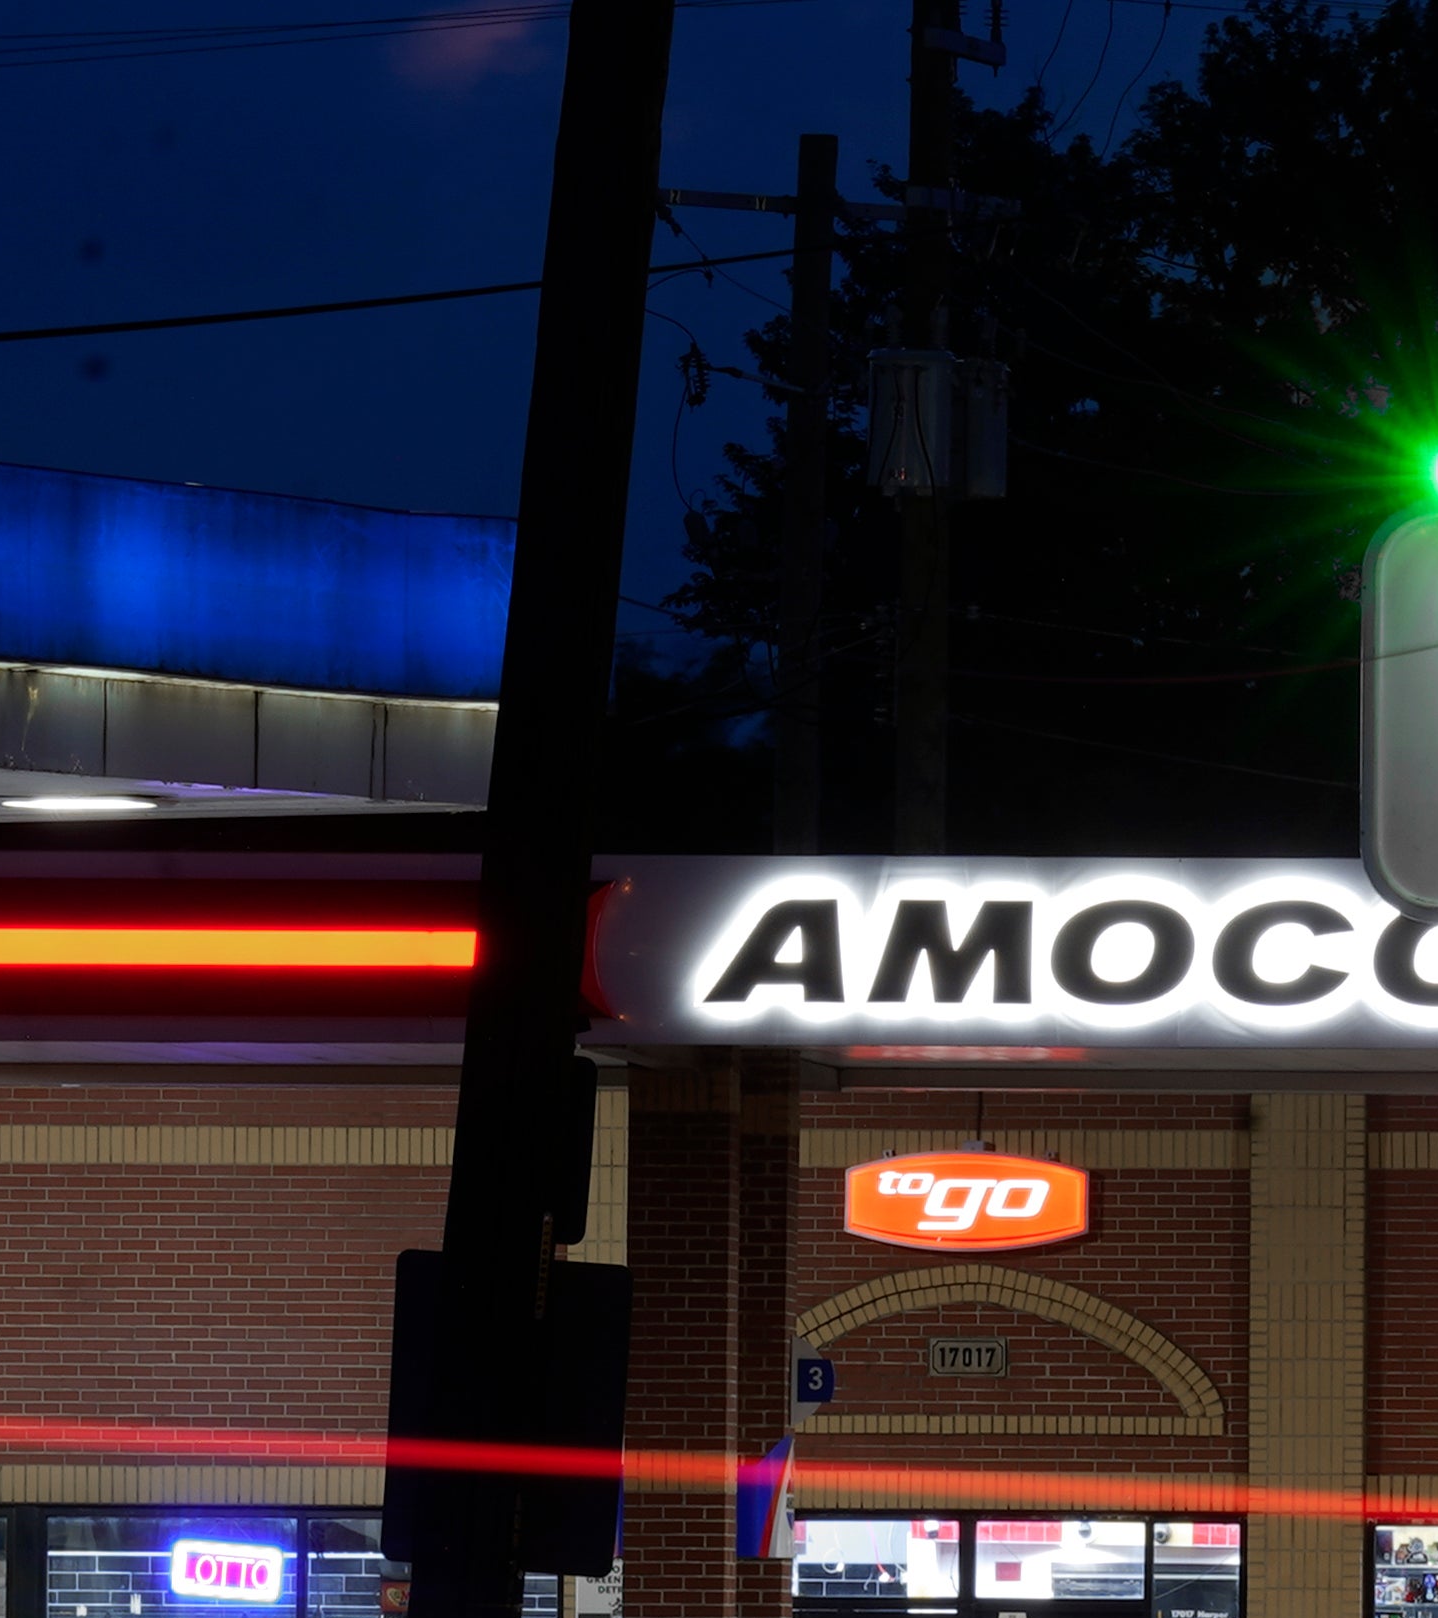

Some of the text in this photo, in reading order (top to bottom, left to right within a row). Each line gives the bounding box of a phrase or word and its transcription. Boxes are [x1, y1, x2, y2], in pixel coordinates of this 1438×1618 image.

[877, 1170, 1050, 1231] to go
[939, 1347, 996, 1367] 17017
[808, 1367, 823, 1390] 3
[183, 1551, 270, 1589] LOTTO
